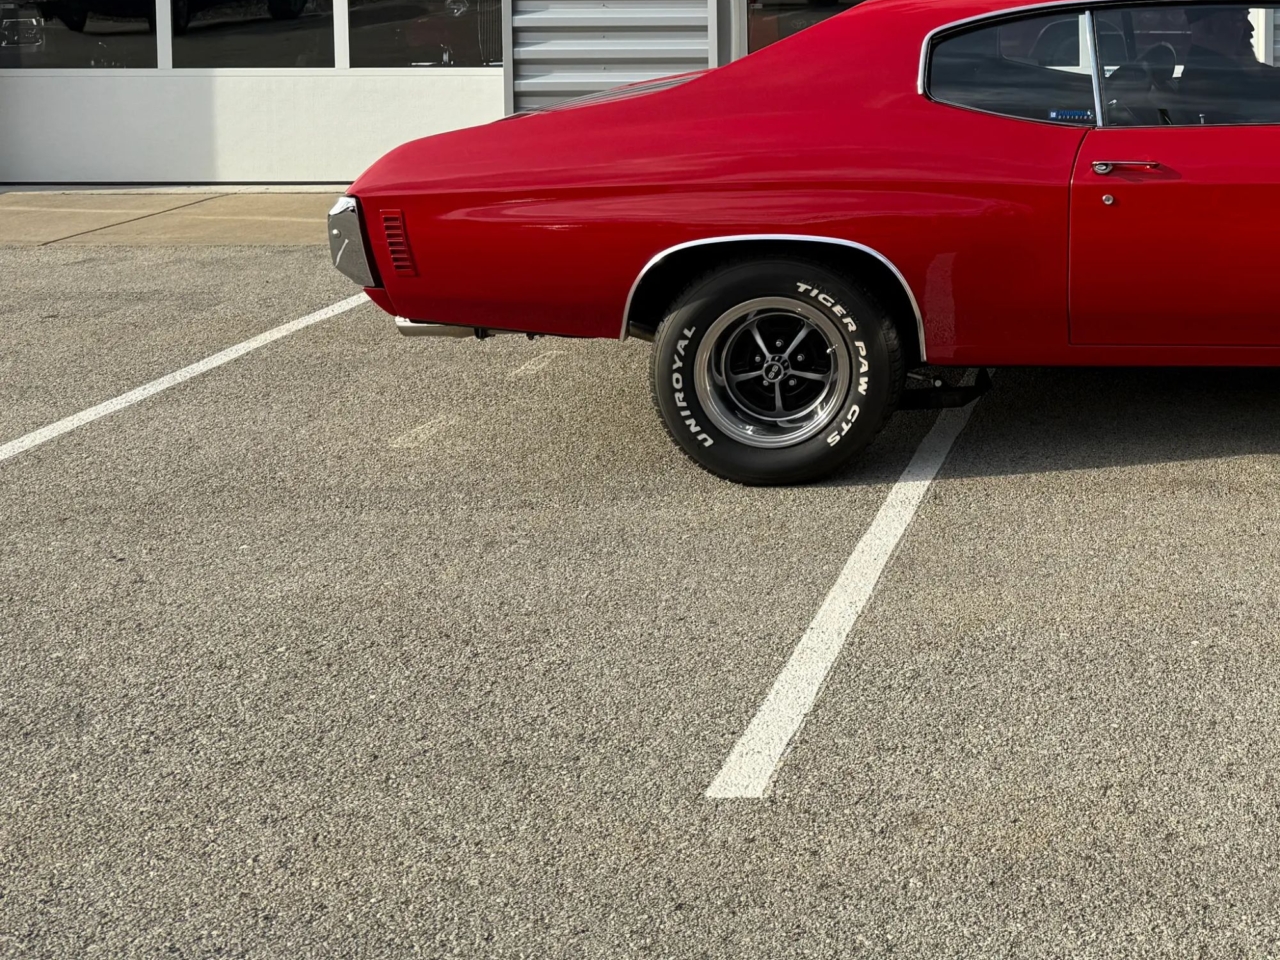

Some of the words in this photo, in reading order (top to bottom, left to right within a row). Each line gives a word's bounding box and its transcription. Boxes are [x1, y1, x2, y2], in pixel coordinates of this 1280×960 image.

[796, 282, 857, 333] TIGER
[672, 325, 714, 447] UNIROYAL
[854, 341, 869, 396] PAW
[826, 404, 860, 447] GTS
